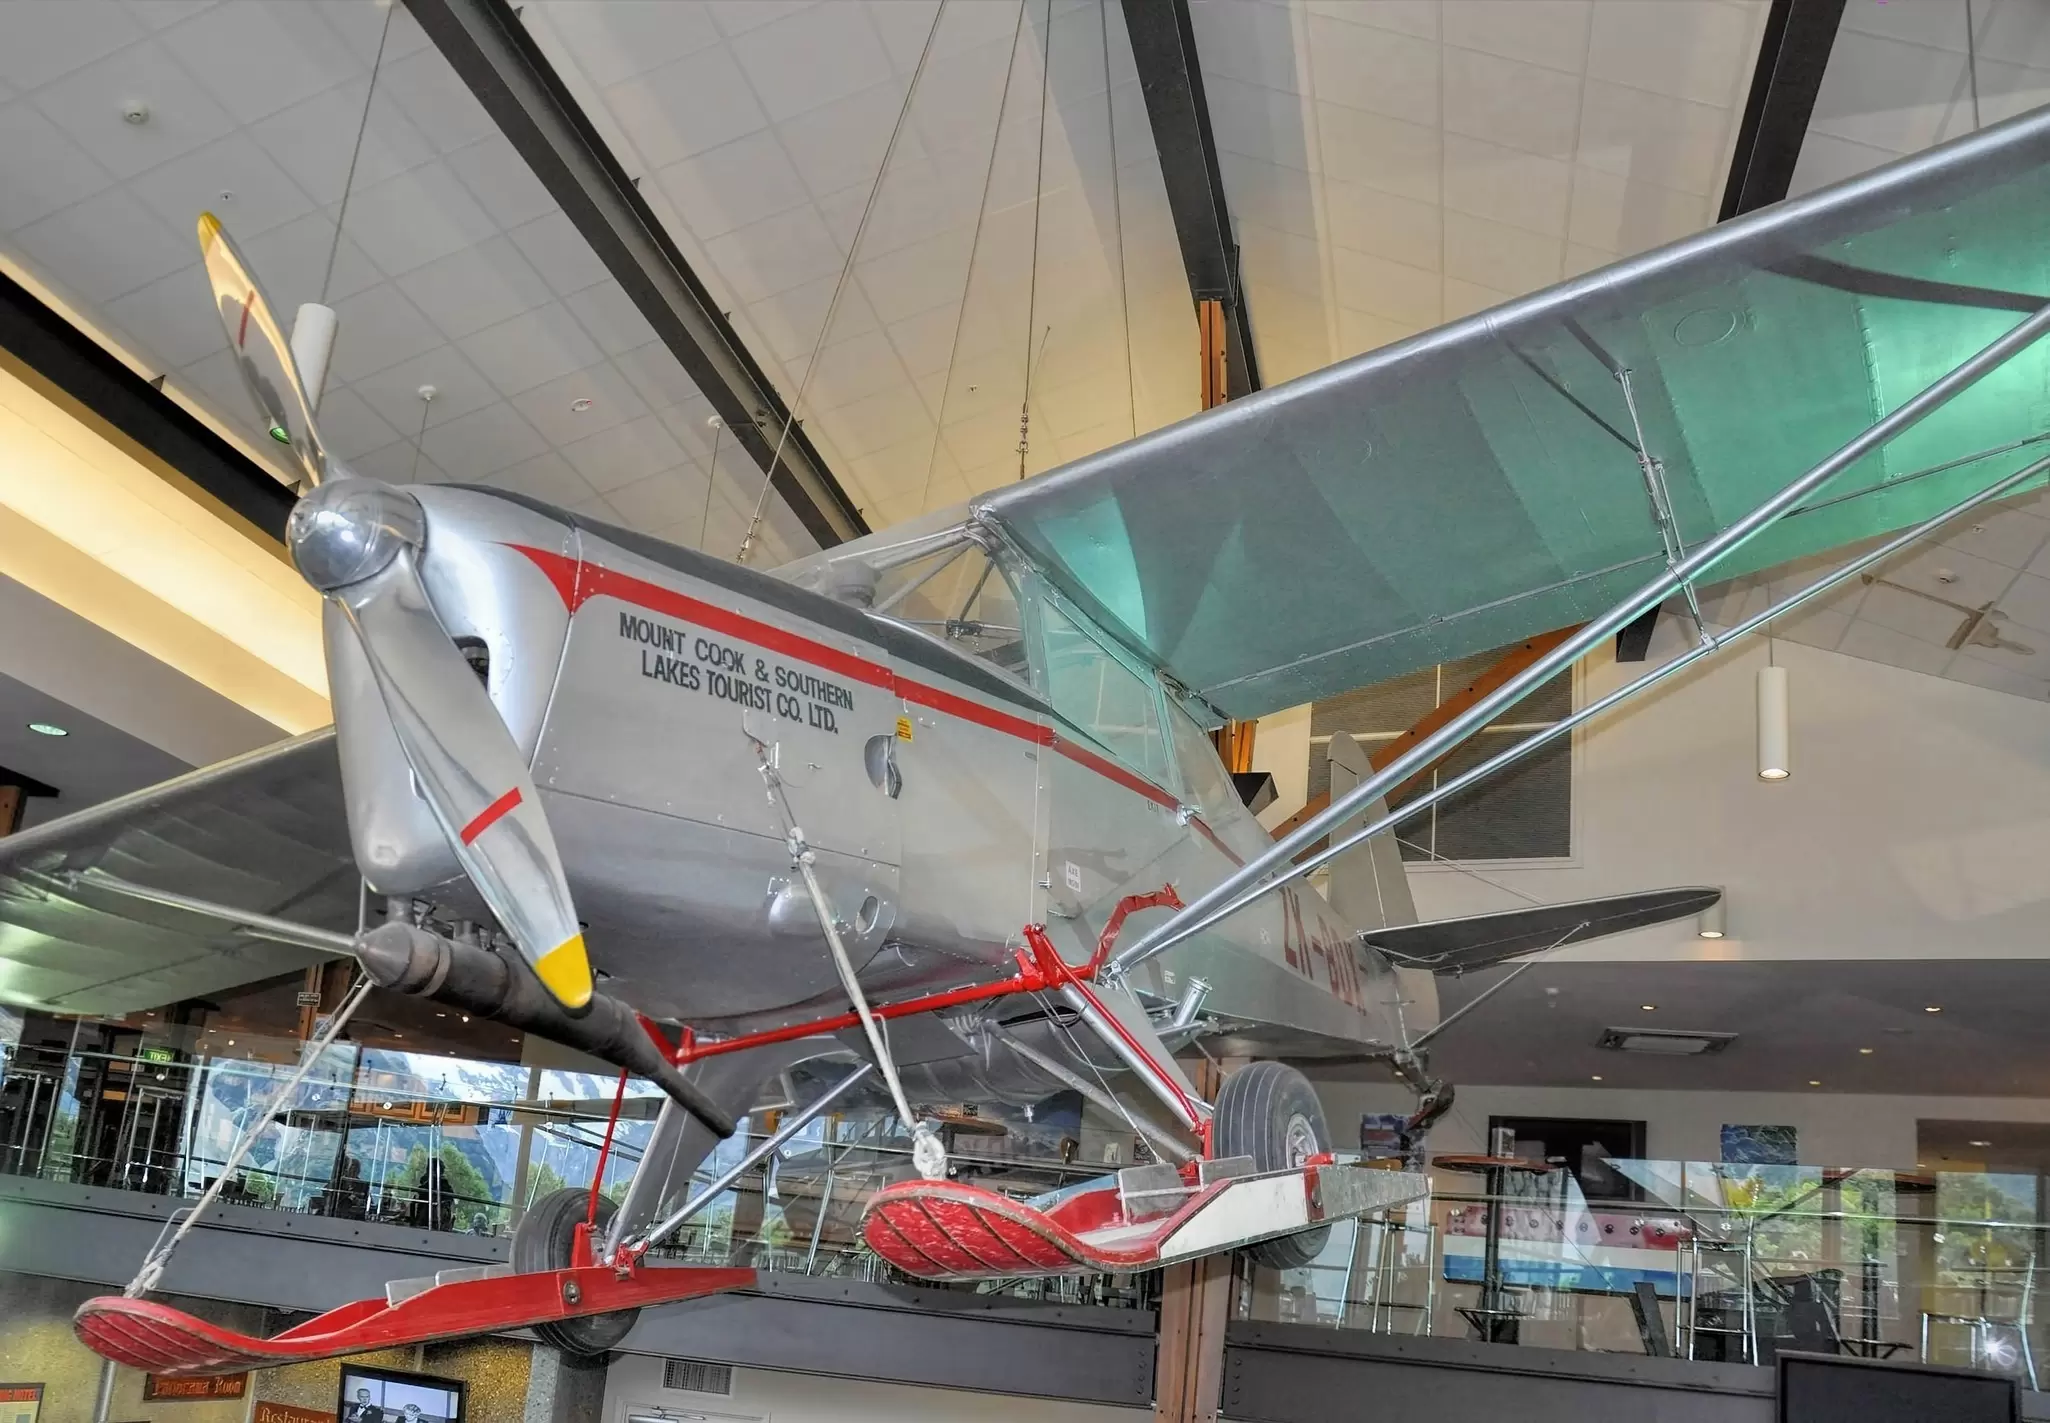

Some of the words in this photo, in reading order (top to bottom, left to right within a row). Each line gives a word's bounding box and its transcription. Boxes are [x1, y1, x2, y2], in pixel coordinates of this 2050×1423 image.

[619, 612, 686, 655] MOUNT
[694, 638, 746, 675] COOK
[754, 658, 770, 683] &
[775, 665, 854, 711] SOUTHERN
[641, 650, 701, 691] LAKES
[706, 669, 772, 713] TOURIST
[776, 692, 803, 723] CO.
[808, 702, 839, 734] LTD.
